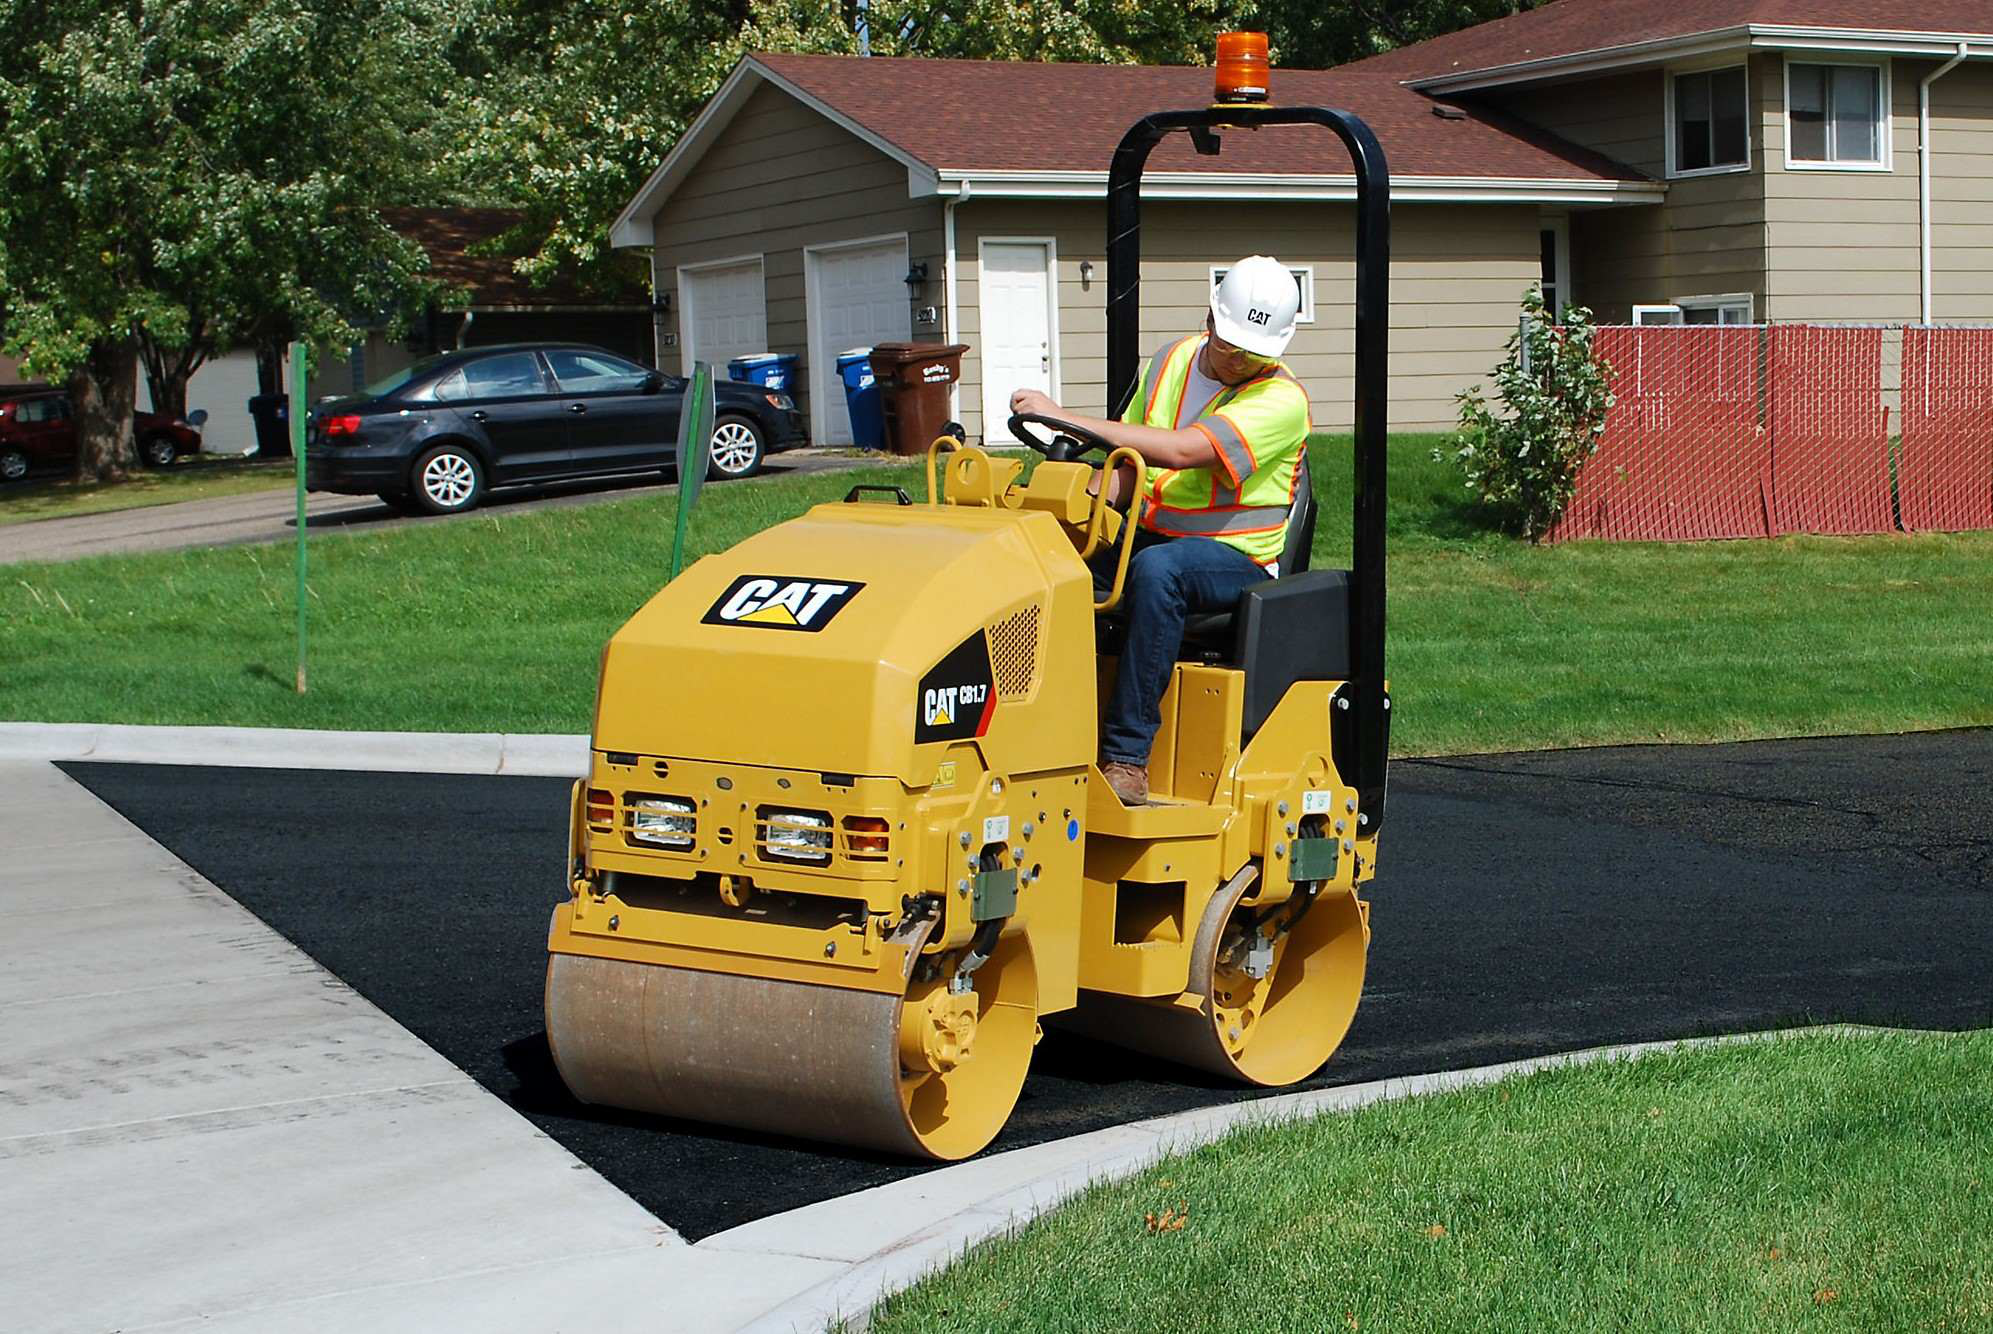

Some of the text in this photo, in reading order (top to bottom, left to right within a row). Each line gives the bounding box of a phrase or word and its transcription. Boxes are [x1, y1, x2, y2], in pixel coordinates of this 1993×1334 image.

[1247, 308, 1272, 326] CAT
[719, 579, 849, 626] CAT
[924, 684, 987, 726] CAT CB1.7
